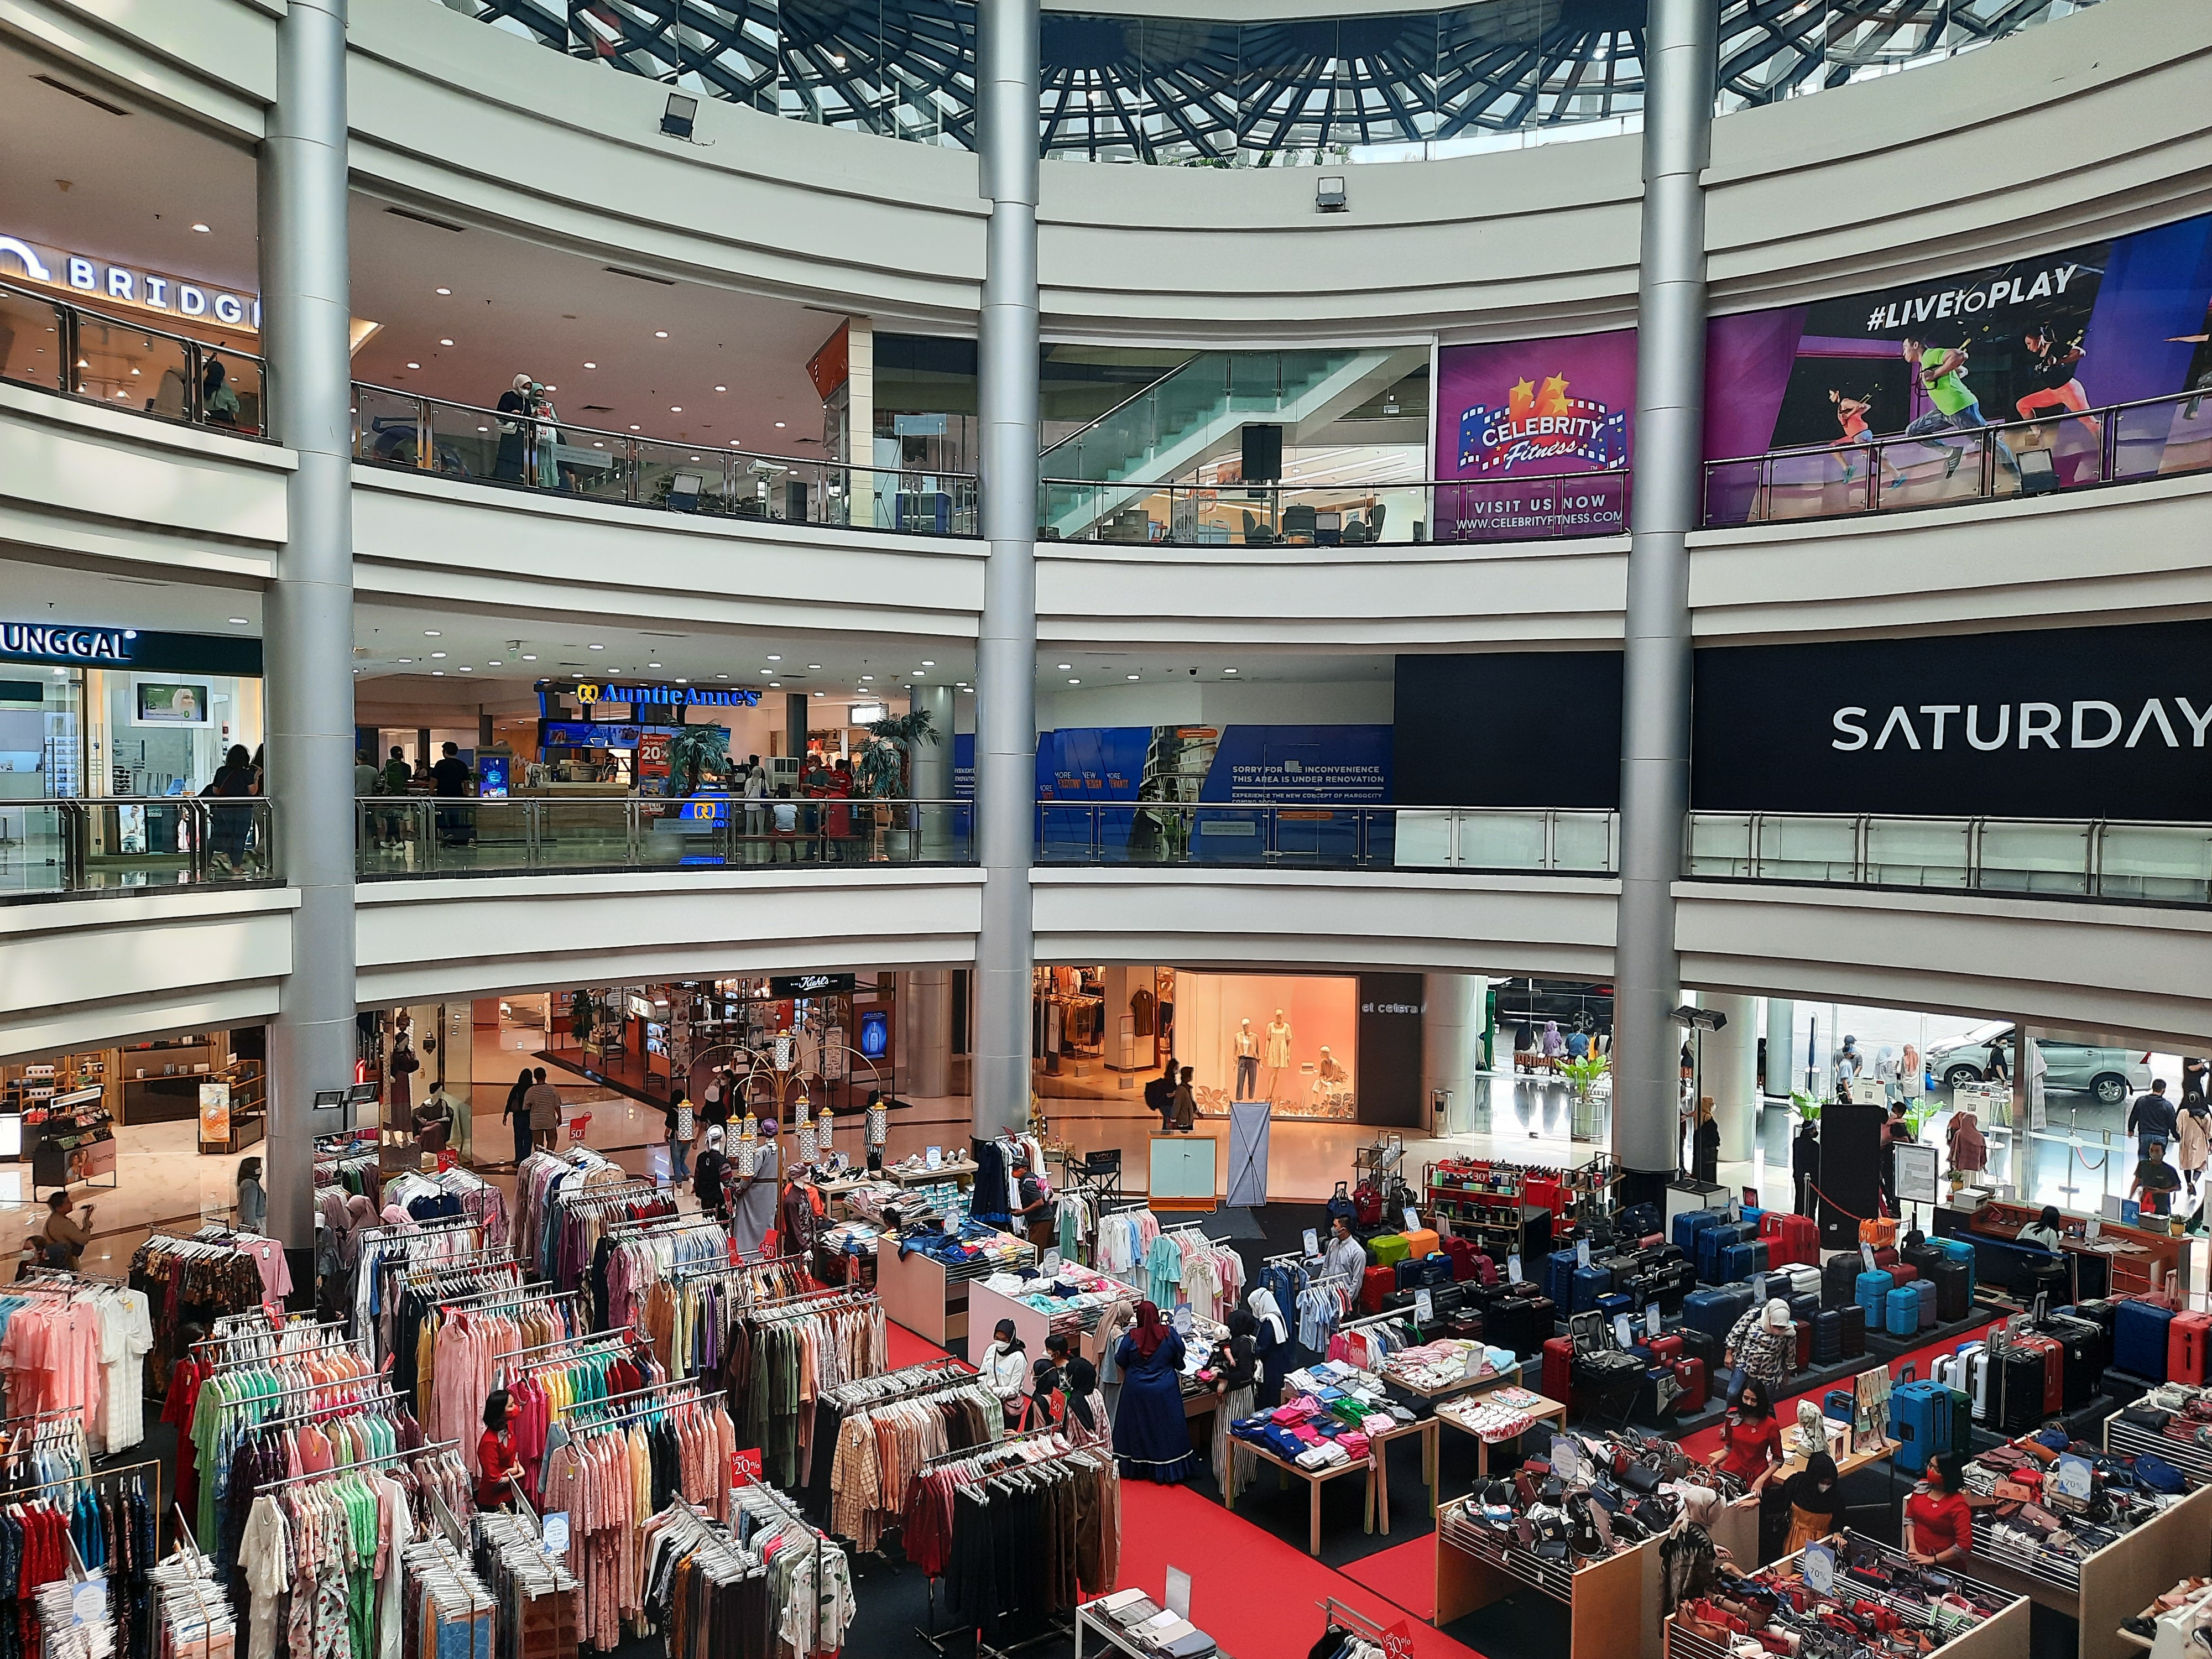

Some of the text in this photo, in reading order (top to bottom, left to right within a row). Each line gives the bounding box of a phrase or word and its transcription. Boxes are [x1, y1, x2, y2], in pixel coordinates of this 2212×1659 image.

[1482, 416, 1605, 446] CELEBRITY
[1505, 440, 1578, 470] Fitness
[1475, 494, 1605, 514] VISIT US NOW
[1456, 511, 1622, 529] WWW.CELEBRITYFITNESS.COM
[0, 624, 133, 660] UNGGAL
[602, 683, 758, 707] Auntie Anne's
[1832, 697, 2212, 750] SATURDAY
[799, 975, 829, 990] Kiehl's
[1361, 1002, 1418, 1014] et cetera
[570, 1129, 584, 1139] 50
[764, 1244, 775, 1256] 50
[1052, 1400, 1061, 1412] 50
[733, 1459, 760, 1475] 20%
[2065, 1479, 2084, 1491] 70%
[1811, 1567, 1827, 1582] 70%
[1386, 1635, 1411, 1659] 30%
